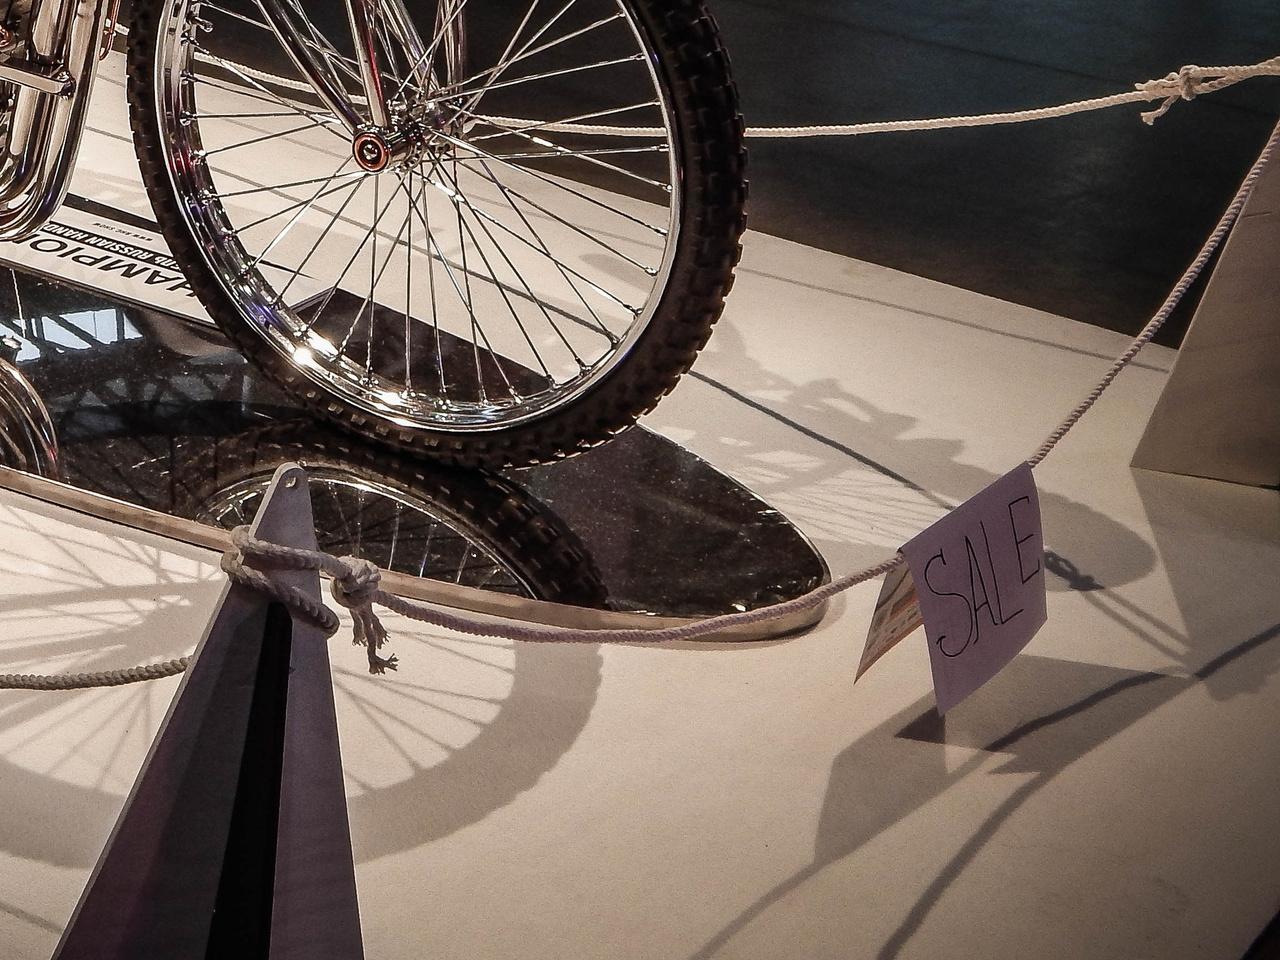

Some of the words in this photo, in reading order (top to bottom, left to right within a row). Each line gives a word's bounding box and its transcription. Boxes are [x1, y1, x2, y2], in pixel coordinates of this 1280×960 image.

[42, 223, 89, 240] HAND
[85, 236, 154, 260] RUSSIAN
[17, 234, 196, 297] HAMPIO
[924, 496, 1040, 657] SALE
